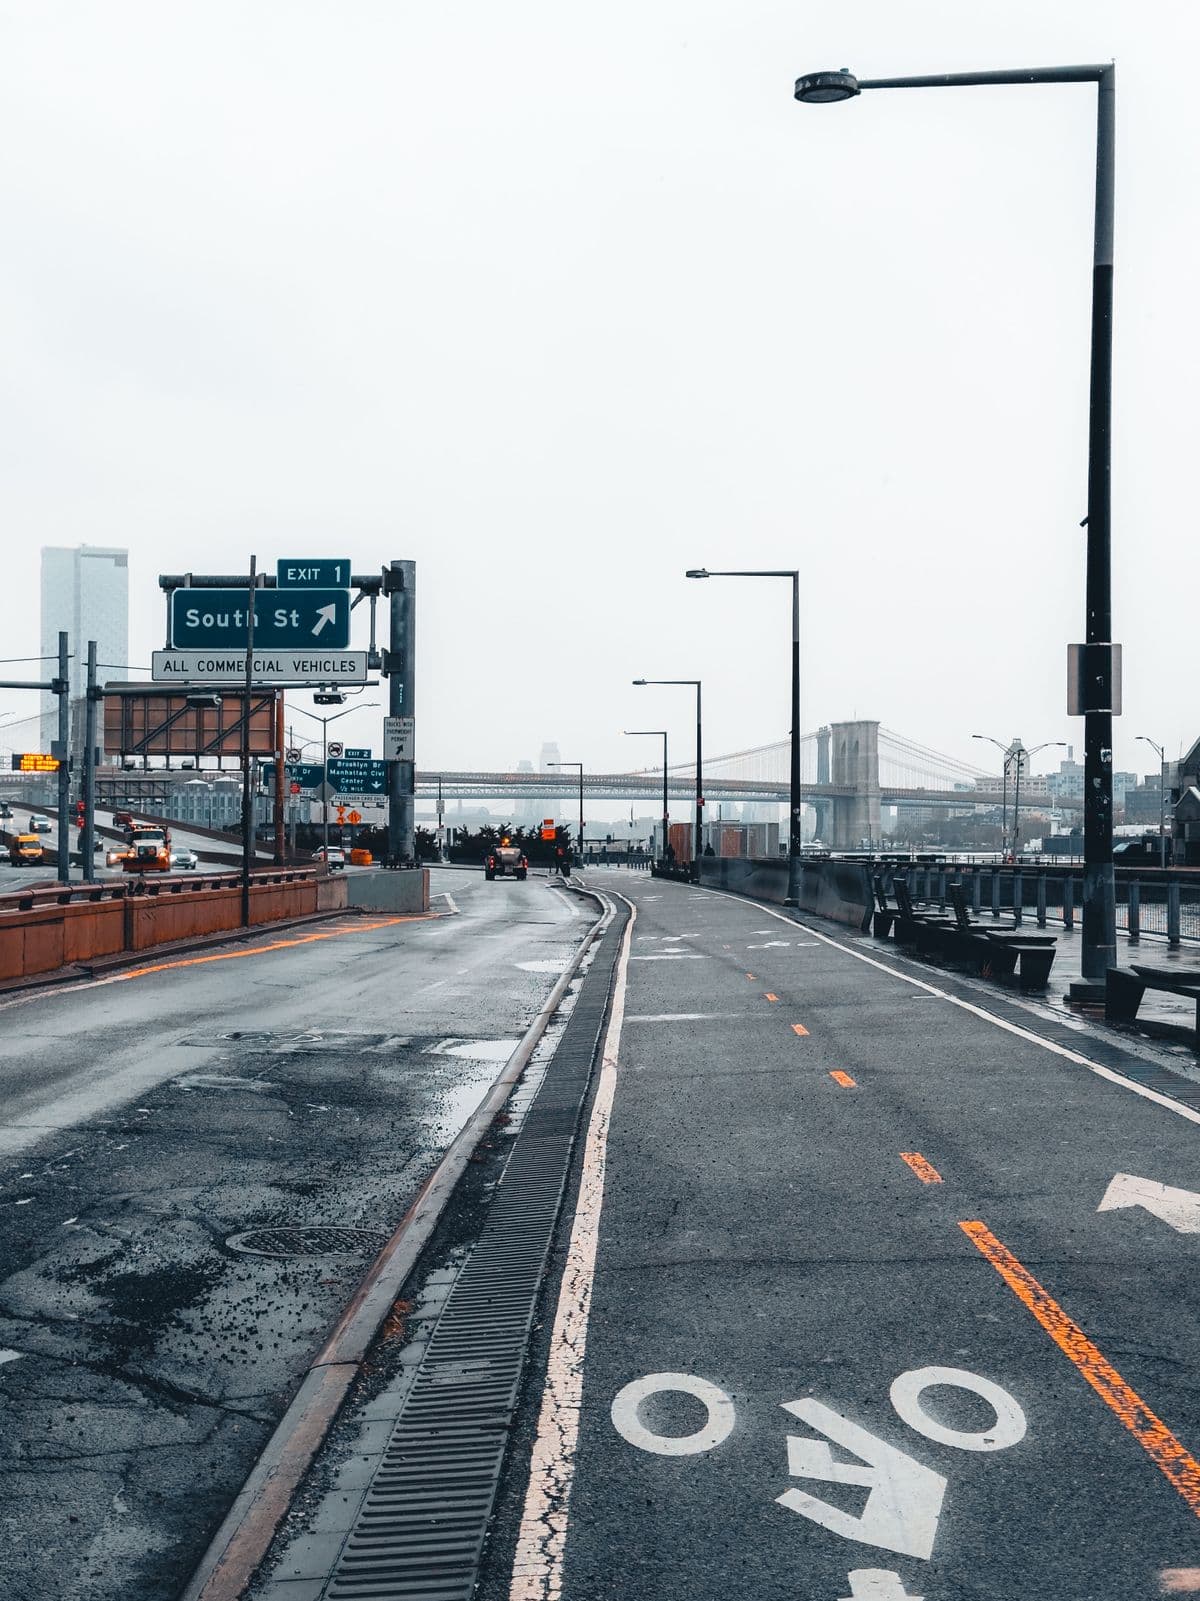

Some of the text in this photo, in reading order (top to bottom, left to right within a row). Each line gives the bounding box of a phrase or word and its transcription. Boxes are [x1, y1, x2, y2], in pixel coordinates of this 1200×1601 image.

[287, 566, 341, 583] EXIT 1
[186, 609, 300, 627] South St
[163, 660, 356, 672] ALL COMMECIAL VEHICLES
[337, 761, 368, 769] Brooklyn
